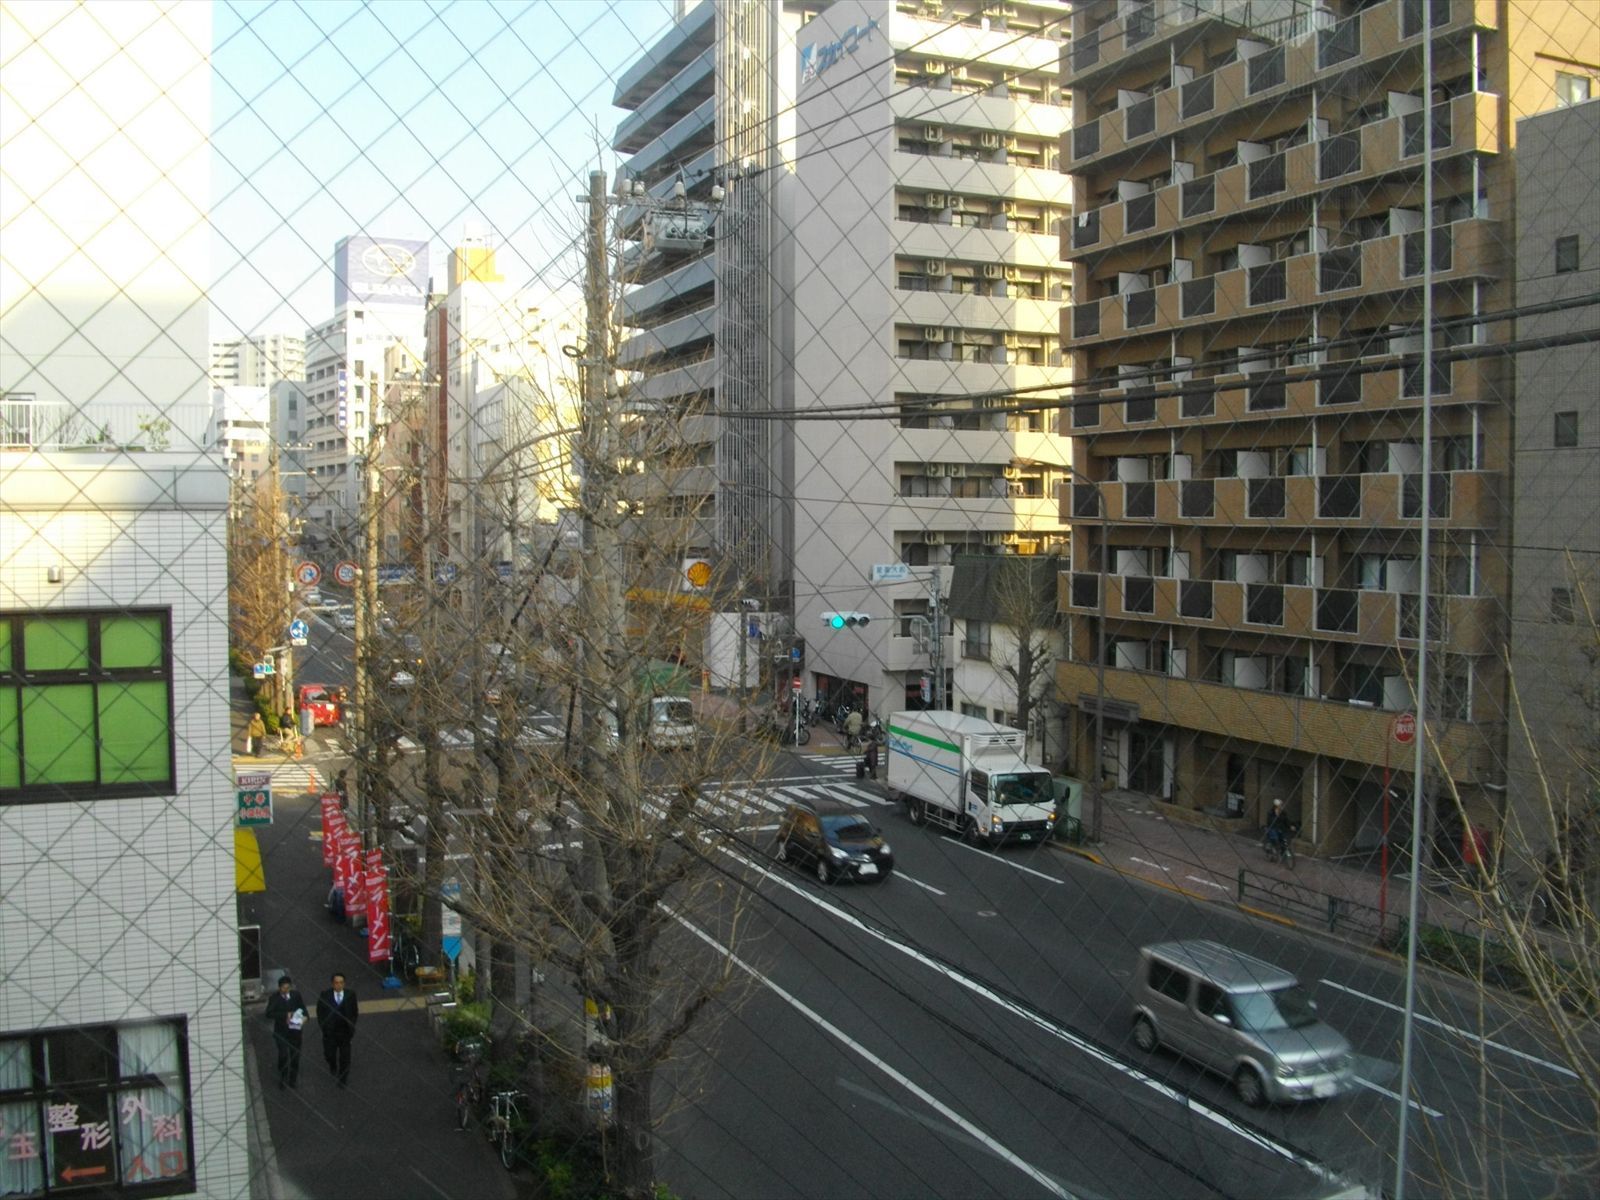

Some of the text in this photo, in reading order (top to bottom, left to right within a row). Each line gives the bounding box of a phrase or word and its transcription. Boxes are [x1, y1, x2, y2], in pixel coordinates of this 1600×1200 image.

[344, 845, 362, 904] ラーメン
[371, 887, 387, 949] ラーメン
[127, 1151, 184, 1180] 入口
